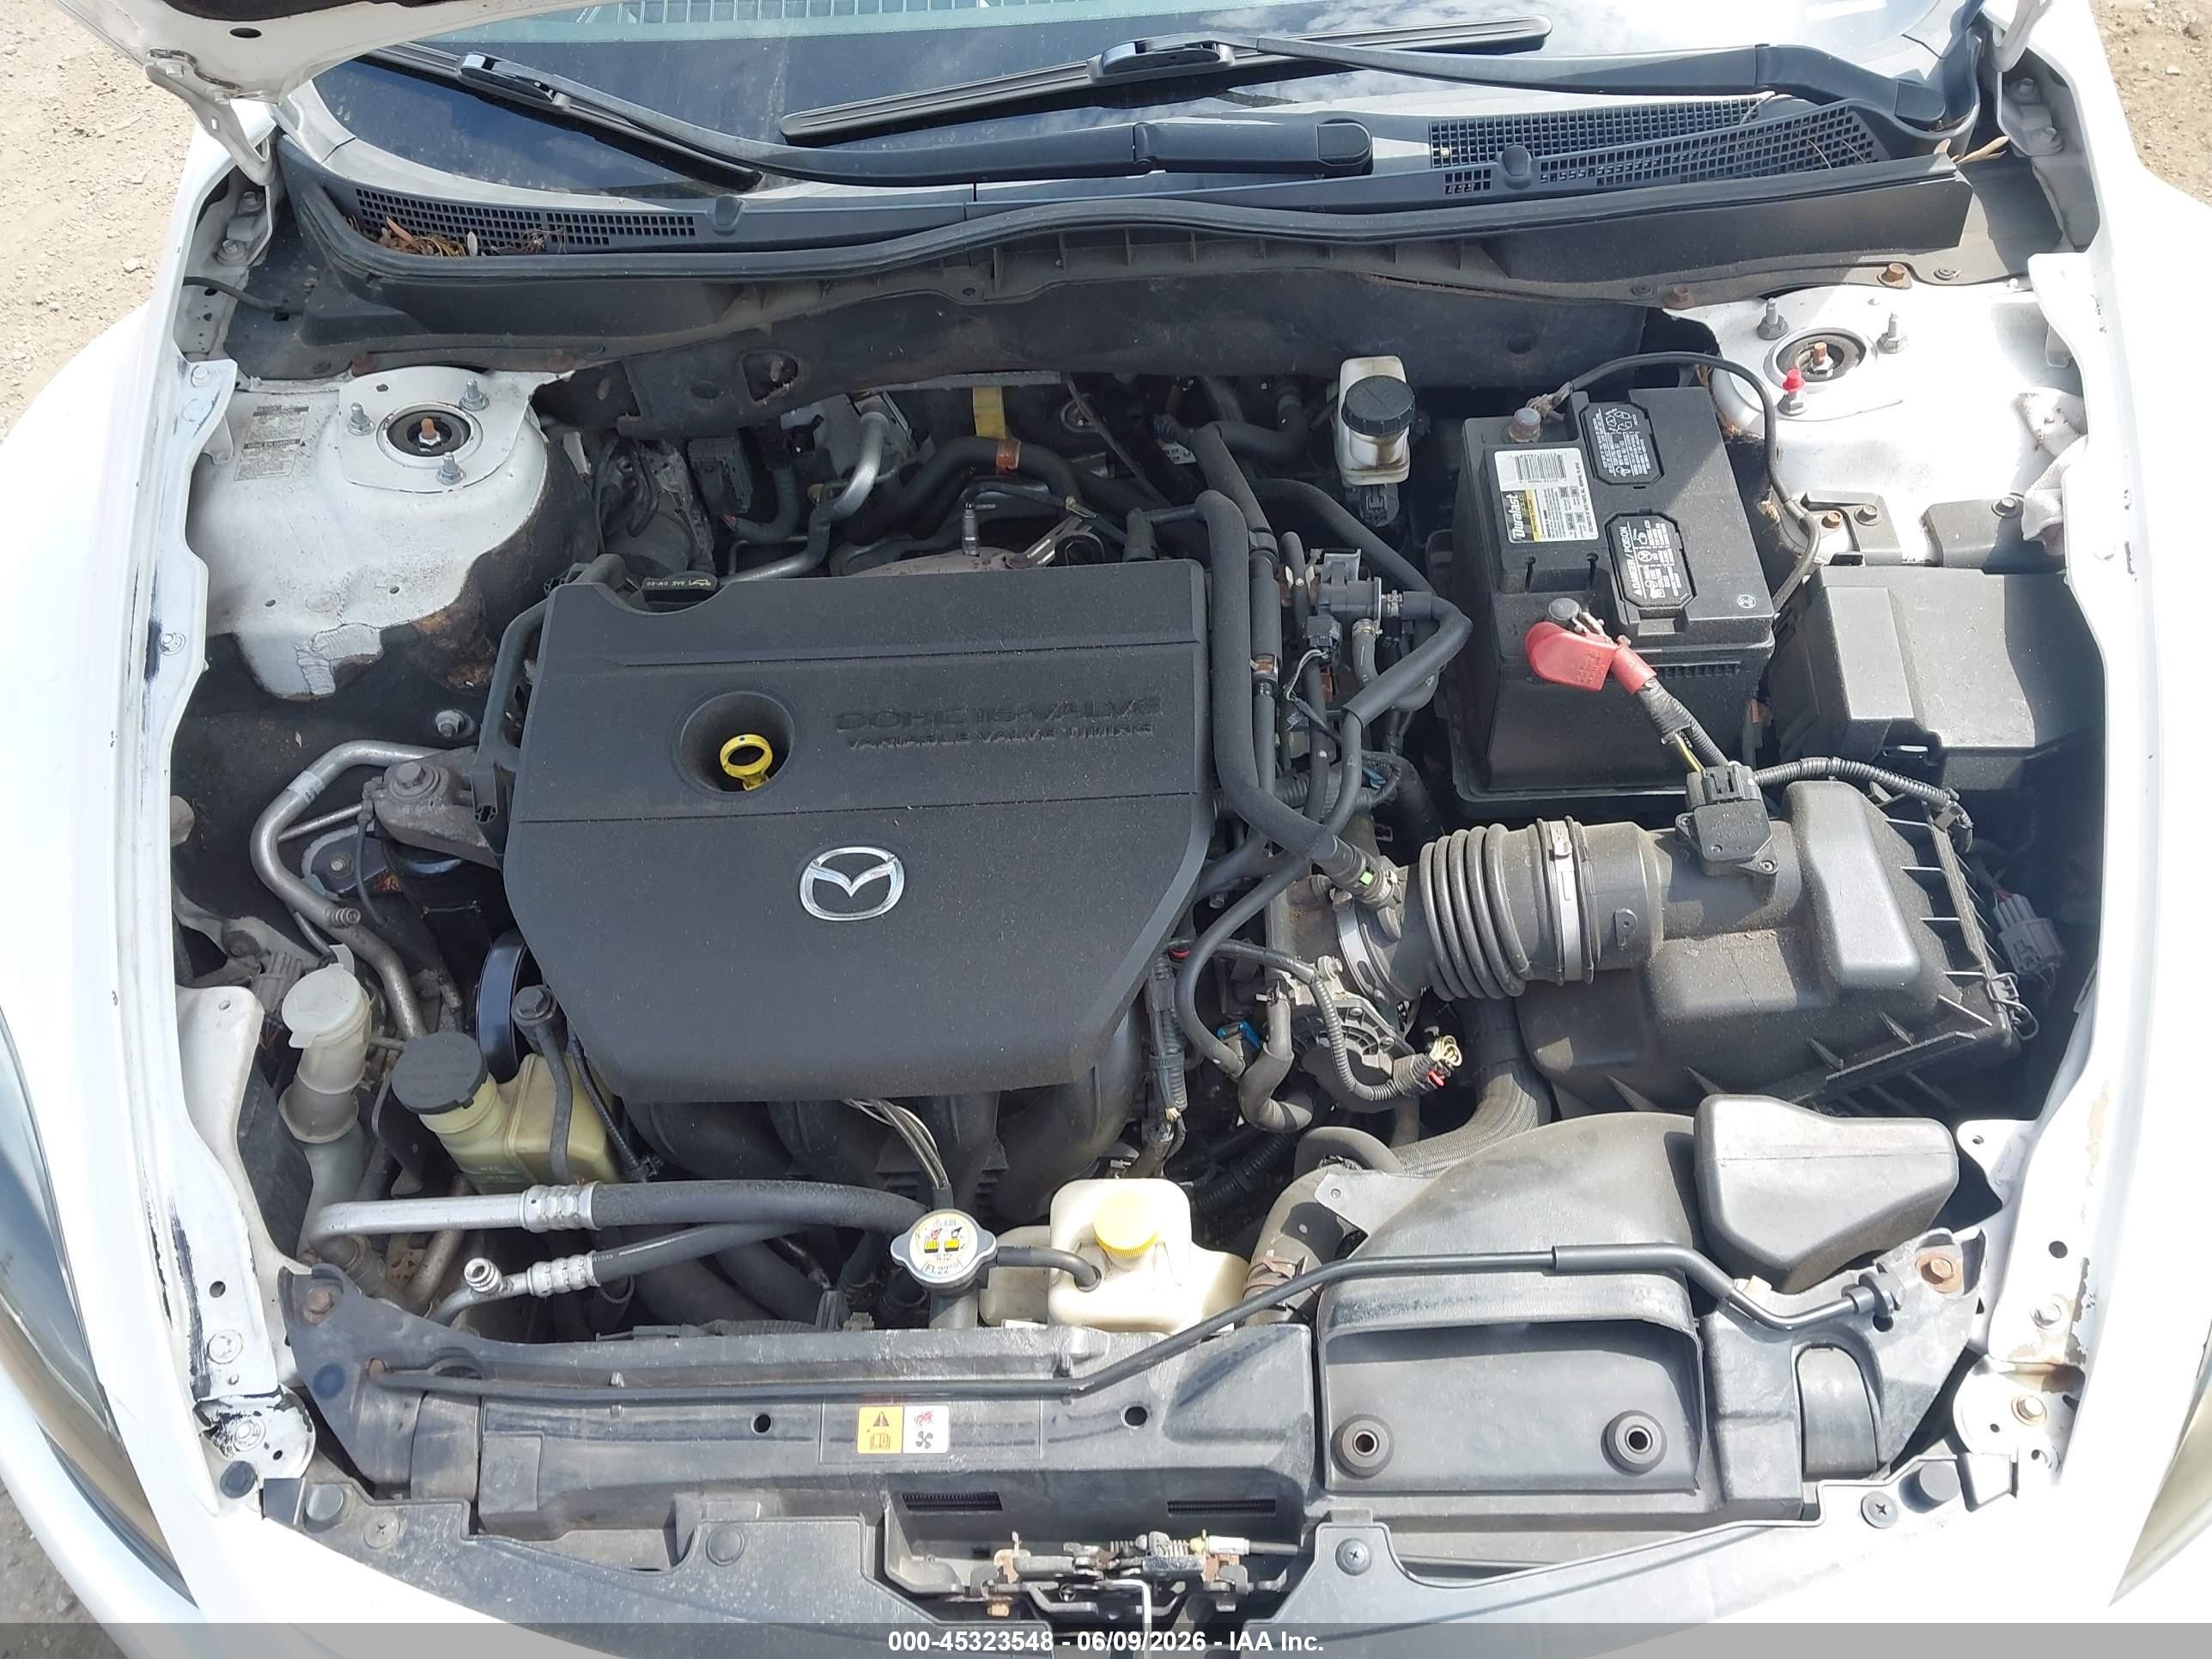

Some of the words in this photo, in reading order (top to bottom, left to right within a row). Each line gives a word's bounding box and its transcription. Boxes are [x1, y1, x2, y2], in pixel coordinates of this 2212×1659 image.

[1505, 493, 1526, 539] Duralast
[1618, 525, 1632, 553] POISON
[1626, 558, 1641, 588] DANGER
[836, 708, 968, 732] DOHC
[847, 728, 971, 750] VARIABLE
[975, 726, 1056, 744] VALVE
[1068, 721, 1154, 740] TIMING
